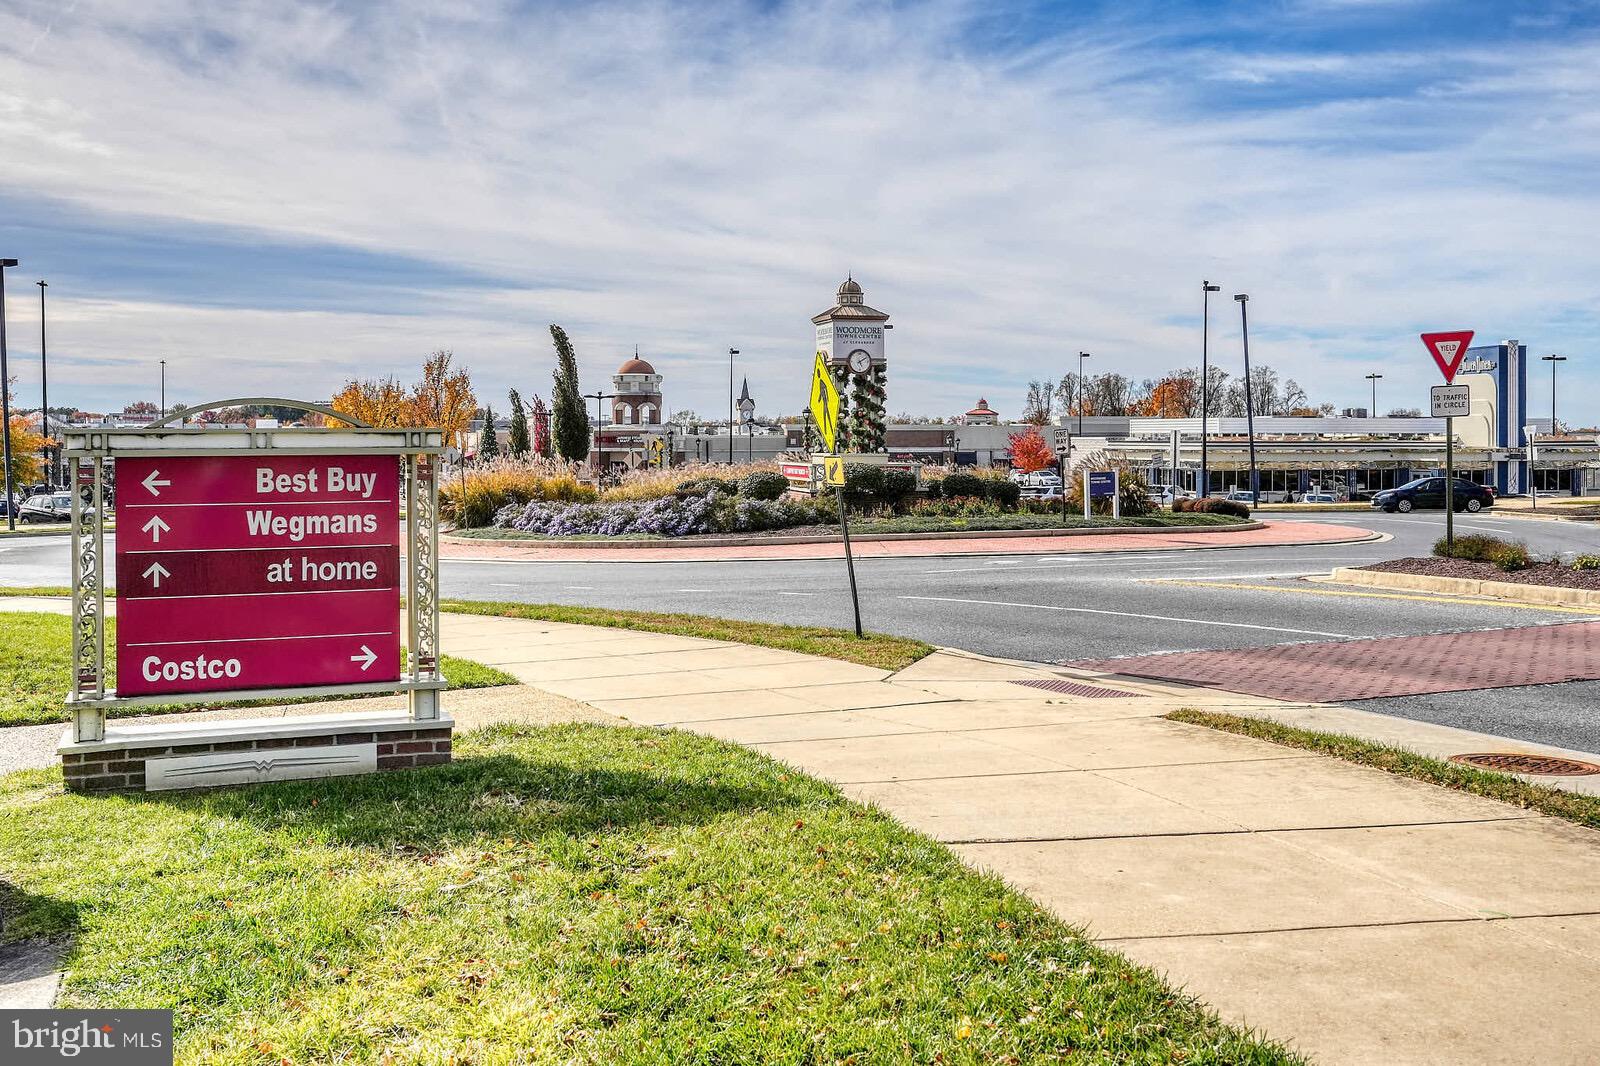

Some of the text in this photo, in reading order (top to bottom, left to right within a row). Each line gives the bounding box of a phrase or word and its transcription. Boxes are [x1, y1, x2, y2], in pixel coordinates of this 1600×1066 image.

[836, 326, 882, 335] WOODMORE
[1440, 344, 1457, 352] YIELD
[1443, 393, 1468, 401] TRAFFIC
[1444, 401, 1466, 409] CIRCLE
[256, 467, 377, 498] Best Buy
[246, 510, 378, 542] Wegmans
[266, 556, 378, 583] at home
[142, 654, 242, 682] Costco
